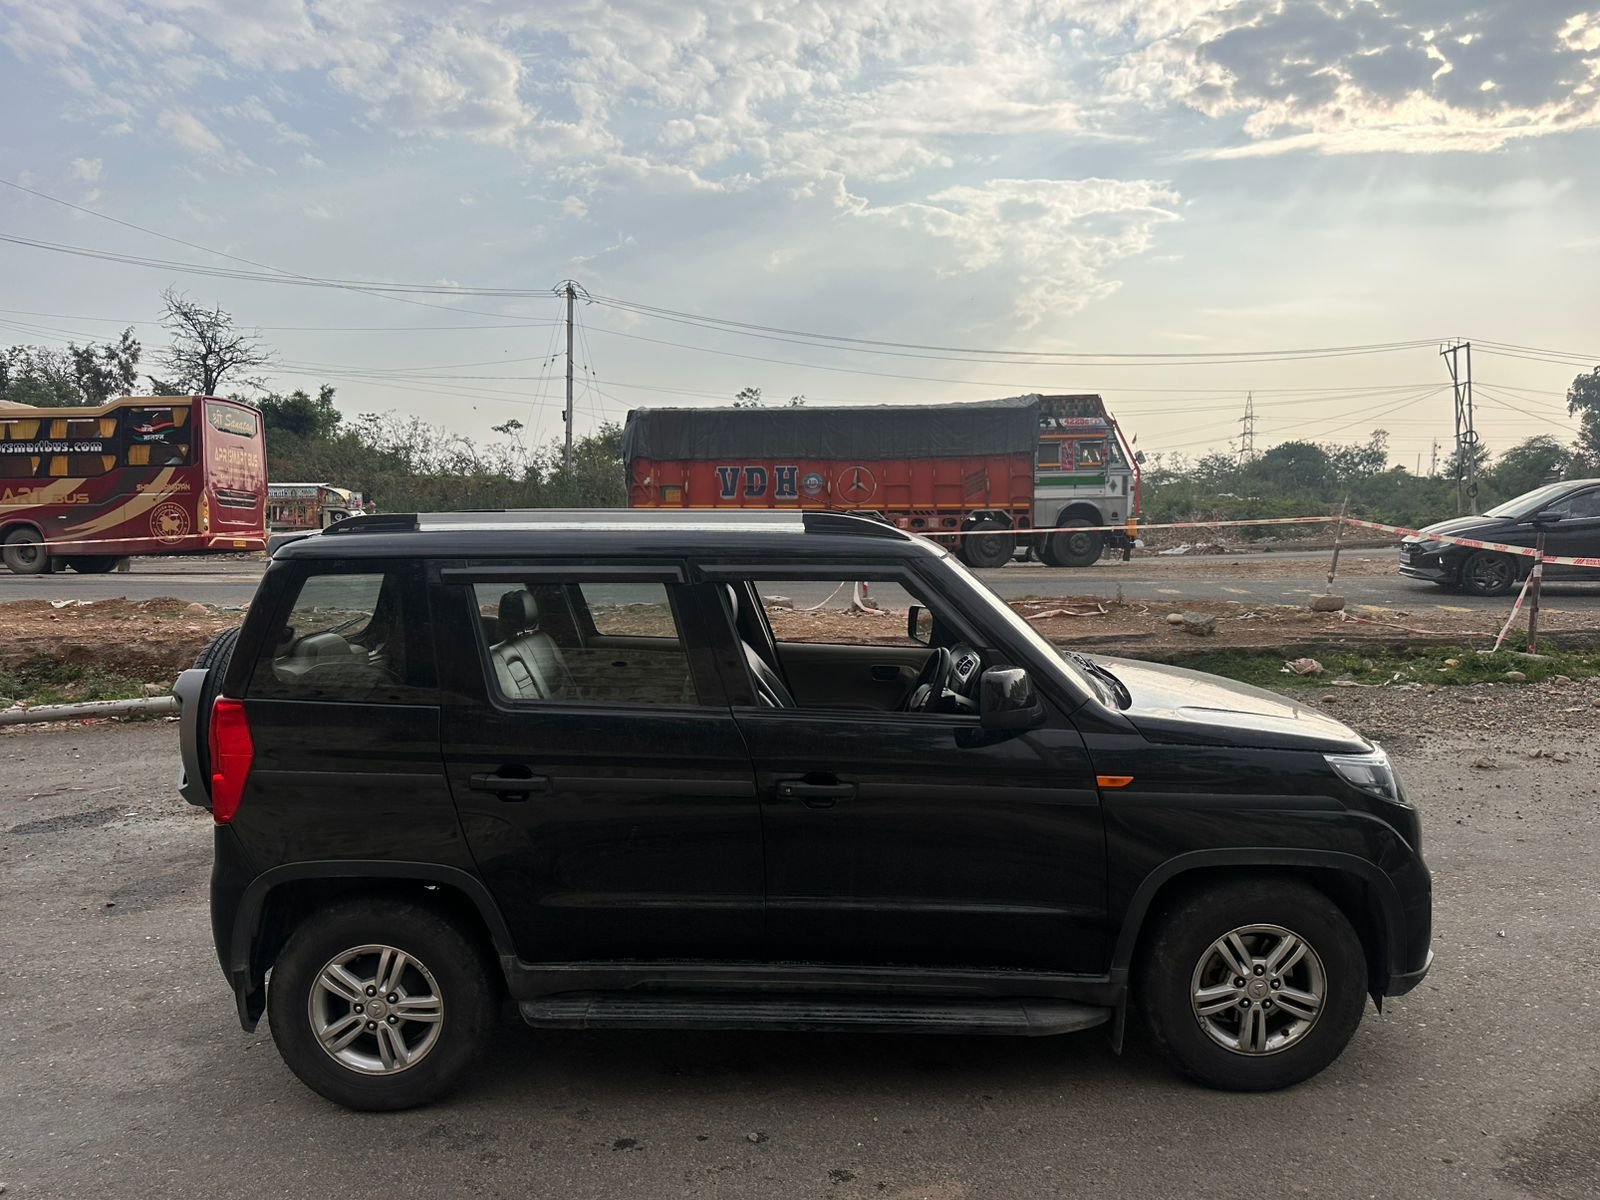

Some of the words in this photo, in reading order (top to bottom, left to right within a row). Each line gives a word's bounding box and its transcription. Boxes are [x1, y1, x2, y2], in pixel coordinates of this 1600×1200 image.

[0, 440, 103, 453] rsmartbus.com
[715, 465, 800, 500] VDH
[53, 493, 90, 504] BUS
